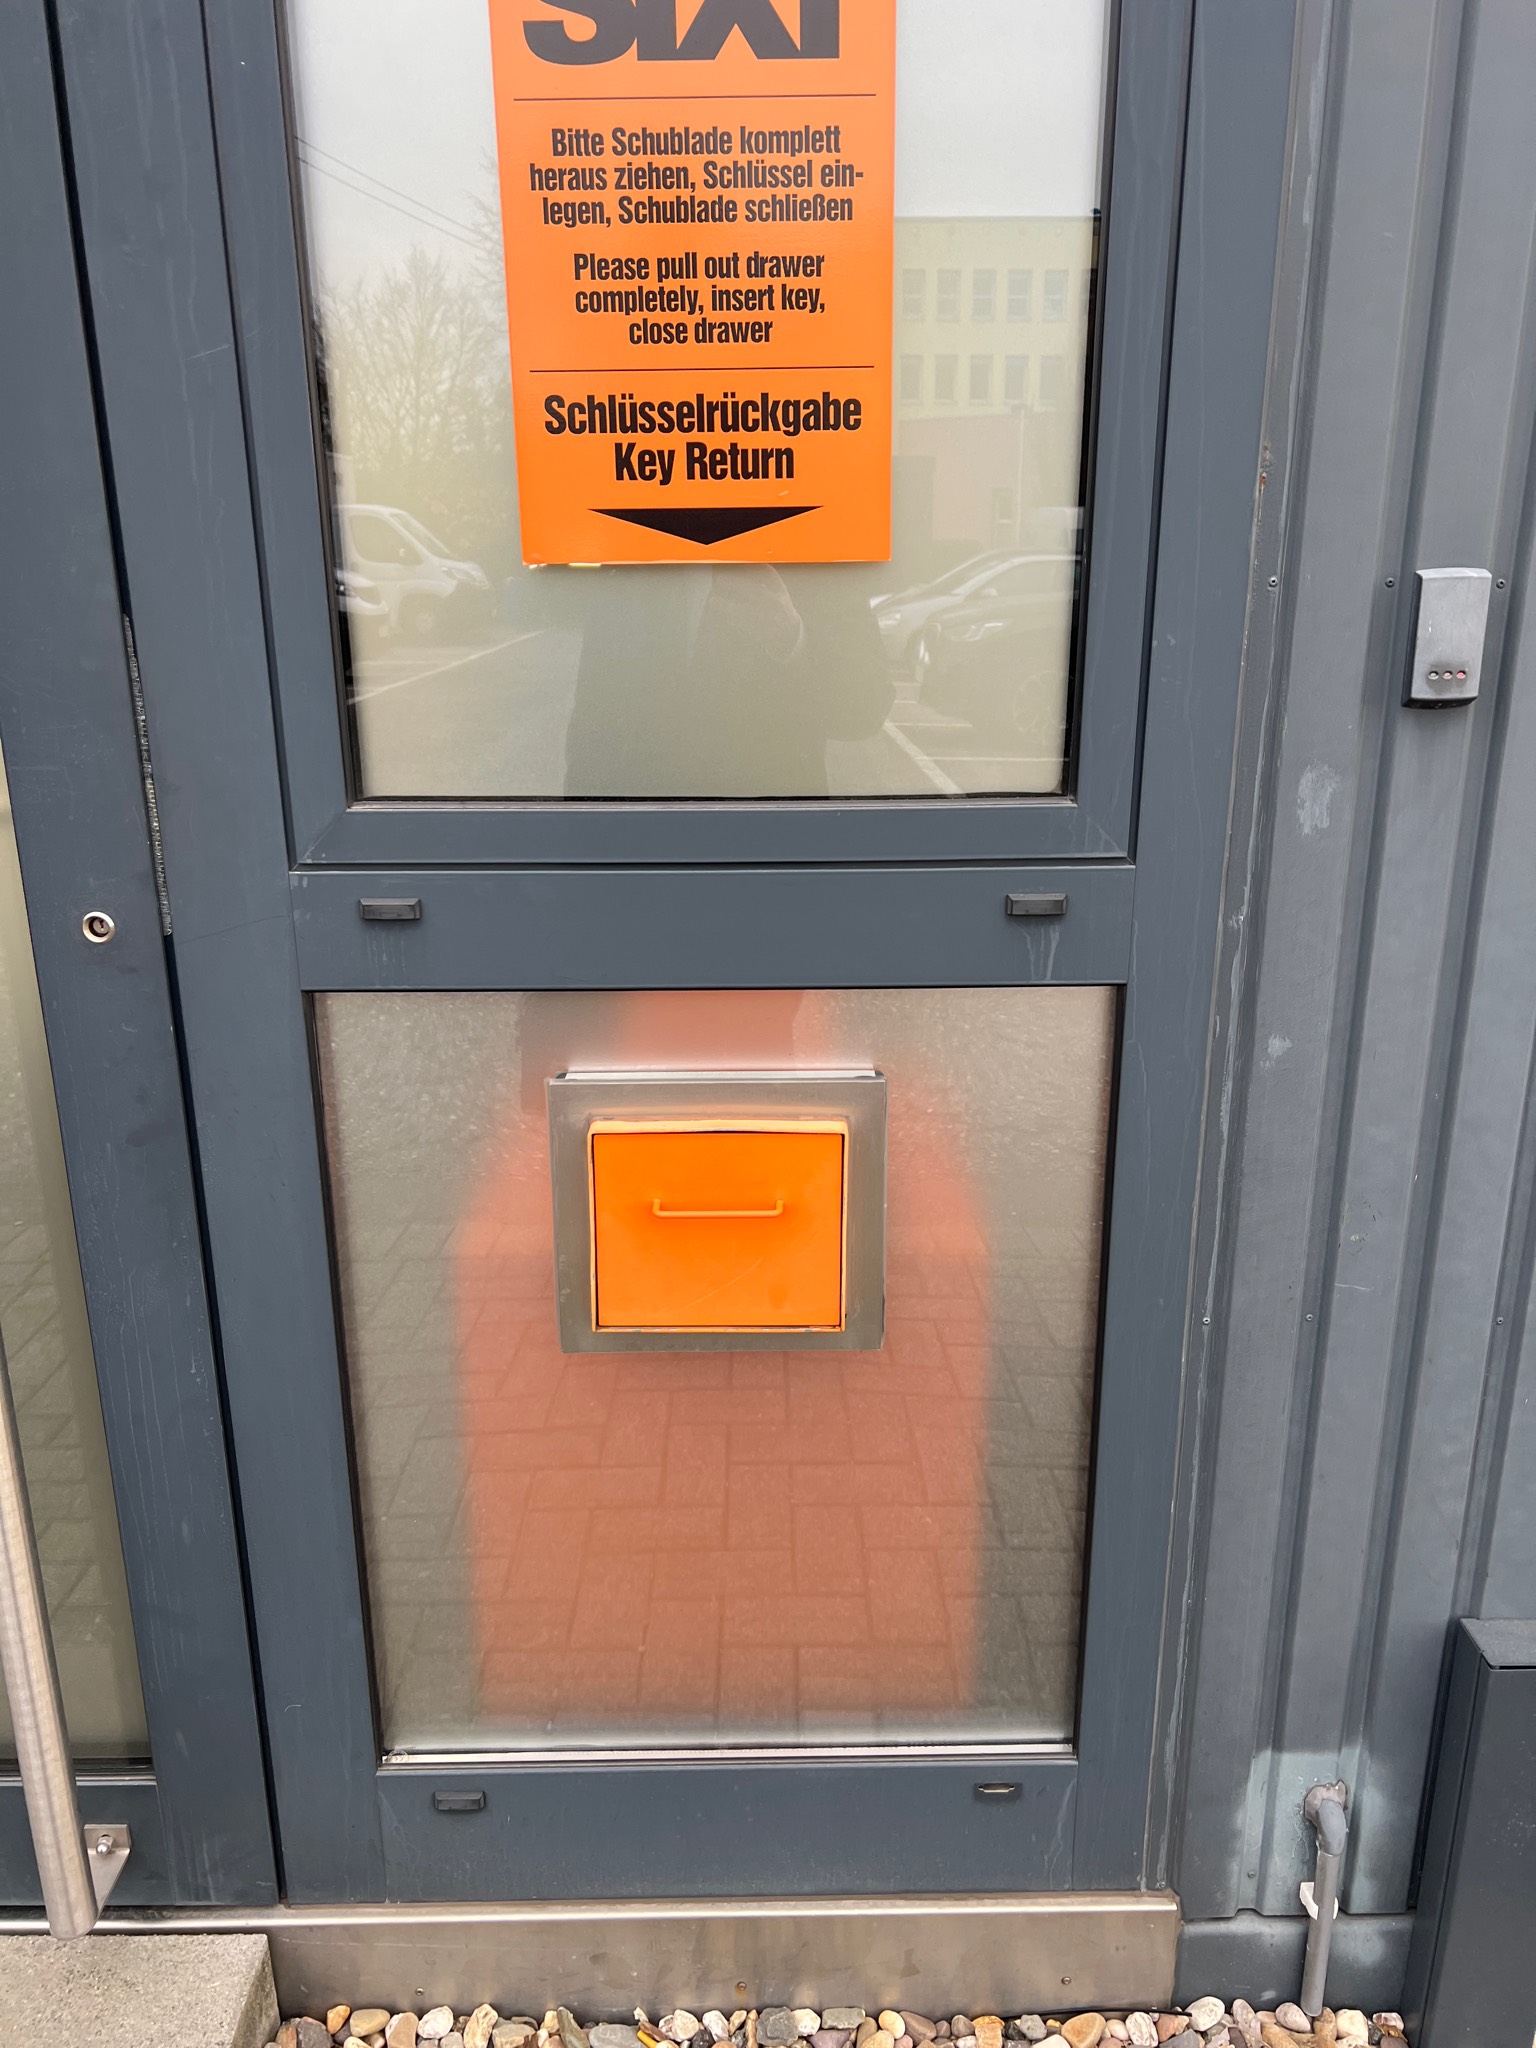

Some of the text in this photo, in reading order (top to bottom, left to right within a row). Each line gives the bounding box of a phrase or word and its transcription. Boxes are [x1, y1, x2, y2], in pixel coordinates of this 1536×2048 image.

[551, 125, 841, 157] Bitte Schublade komplett
[529, 159, 864, 193] heraus ziehen, Schlüssel ein-
[542, 193, 853, 229] legen, Schublade schließen
[573, 250, 825, 283] Please pull out drawer
[575, 283, 825, 316] completely, insert key,
[628, 317, 773, 345] close drawer
[544, 391, 862, 437] Schlüsselrückgabe
[614, 441, 795, 486] Key Return
